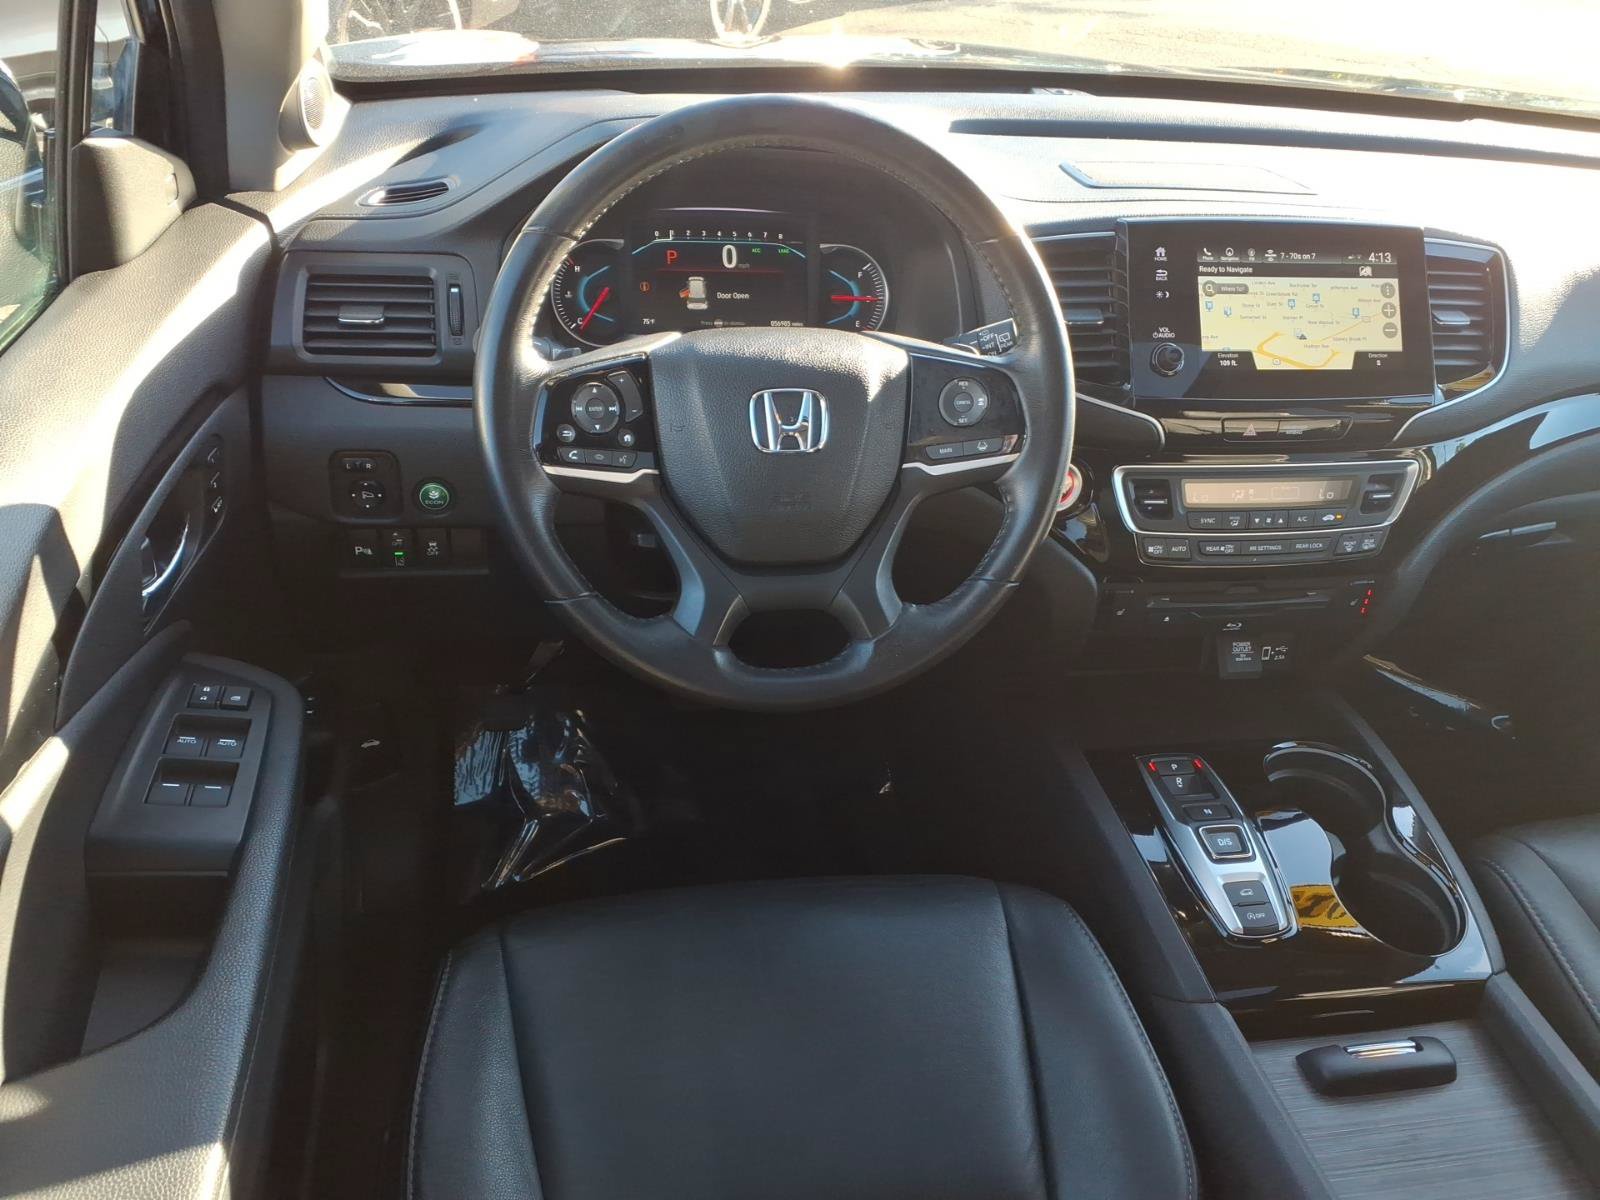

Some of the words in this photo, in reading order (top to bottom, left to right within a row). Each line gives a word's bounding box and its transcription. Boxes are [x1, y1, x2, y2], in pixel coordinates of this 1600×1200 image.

[666, 249, 678, 265] P
[721, 244, 738, 269] 0
[1280, 252, 1285, 260] 7
[1311, 252, 1316, 260] 7
[1368, 252, 1392, 263] 4:13
[1199, 265, 1218, 274] Ready
[1218, 265, 1225, 273] to
[1226, 265, 1253, 275] Navigate
[733, 292, 750, 300] Open
[1171, 763, 1178, 771] P
[1217, 837, 1233, 846] D/S
